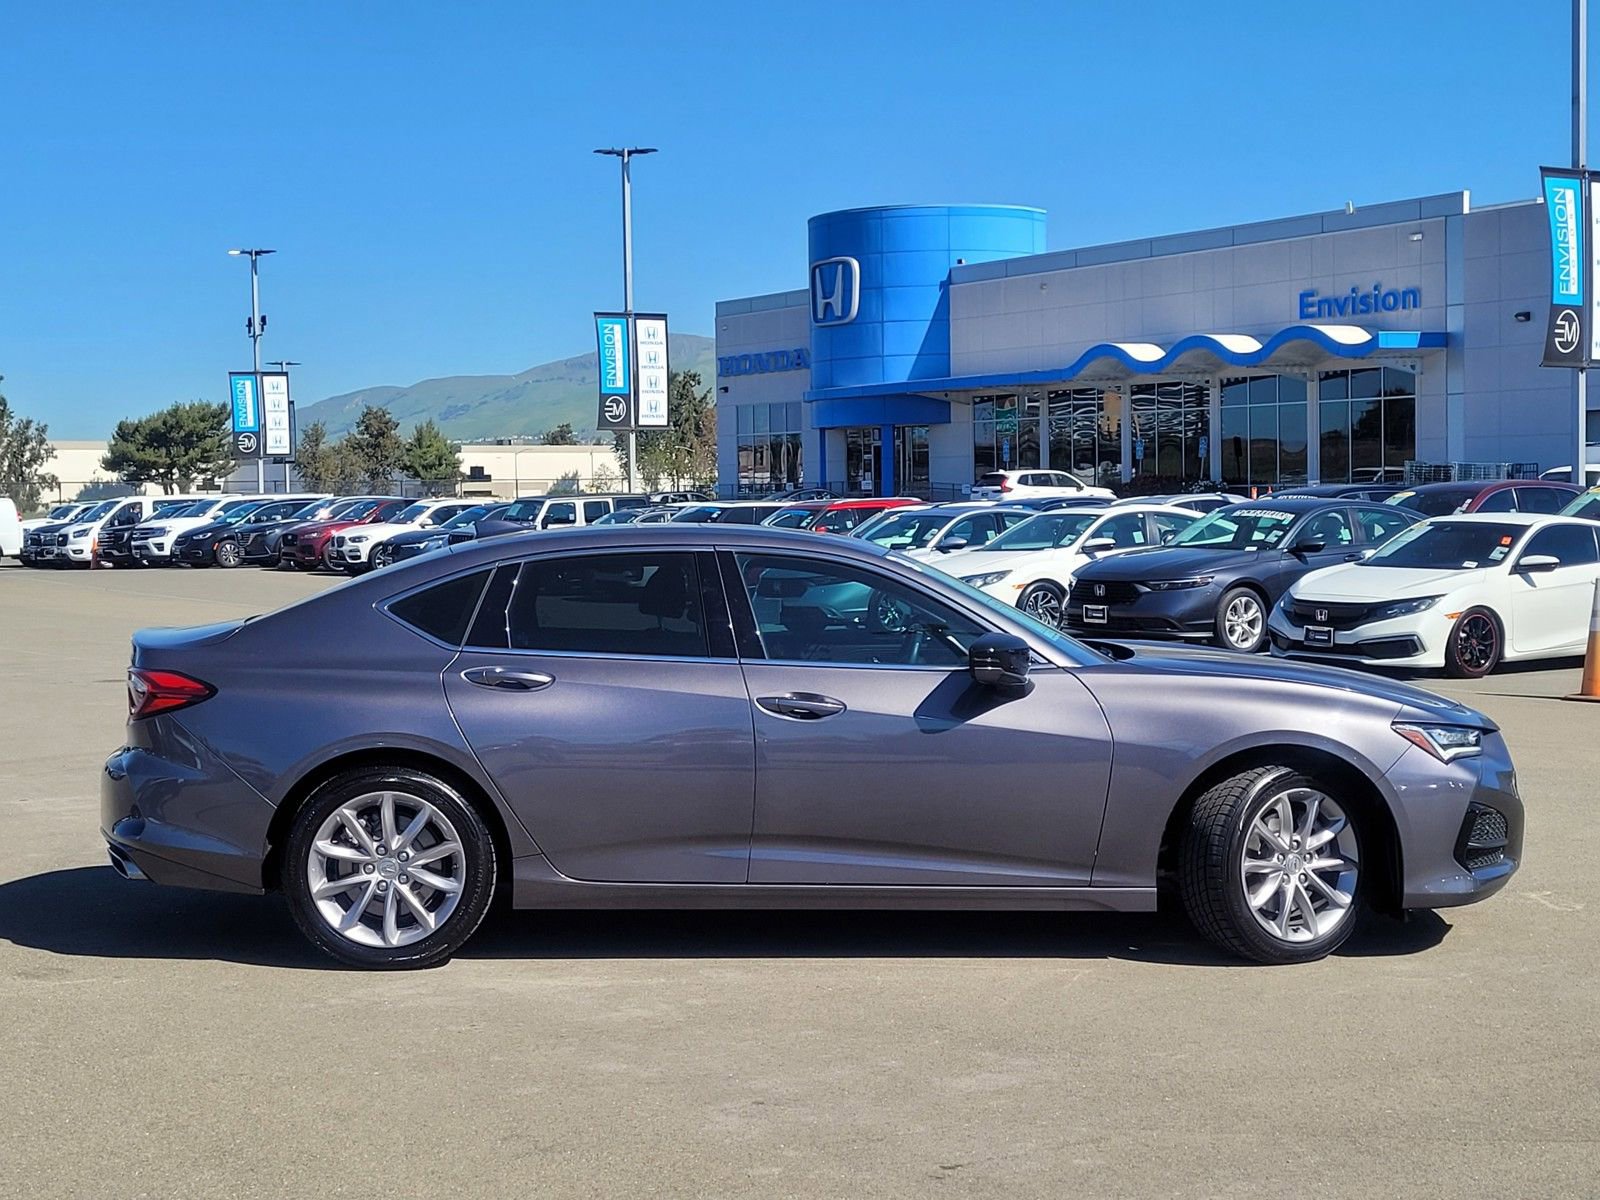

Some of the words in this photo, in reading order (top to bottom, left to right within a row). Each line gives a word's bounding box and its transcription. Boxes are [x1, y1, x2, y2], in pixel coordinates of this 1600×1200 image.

[1552, 187, 1571, 294] ENVISION
[1299, 281, 1421, 320] Envision
[603, 324, 617, 388] ENVISION
[717, 348, 810, 377] HONDA
[235, 379, 248, 428] ENVISION
